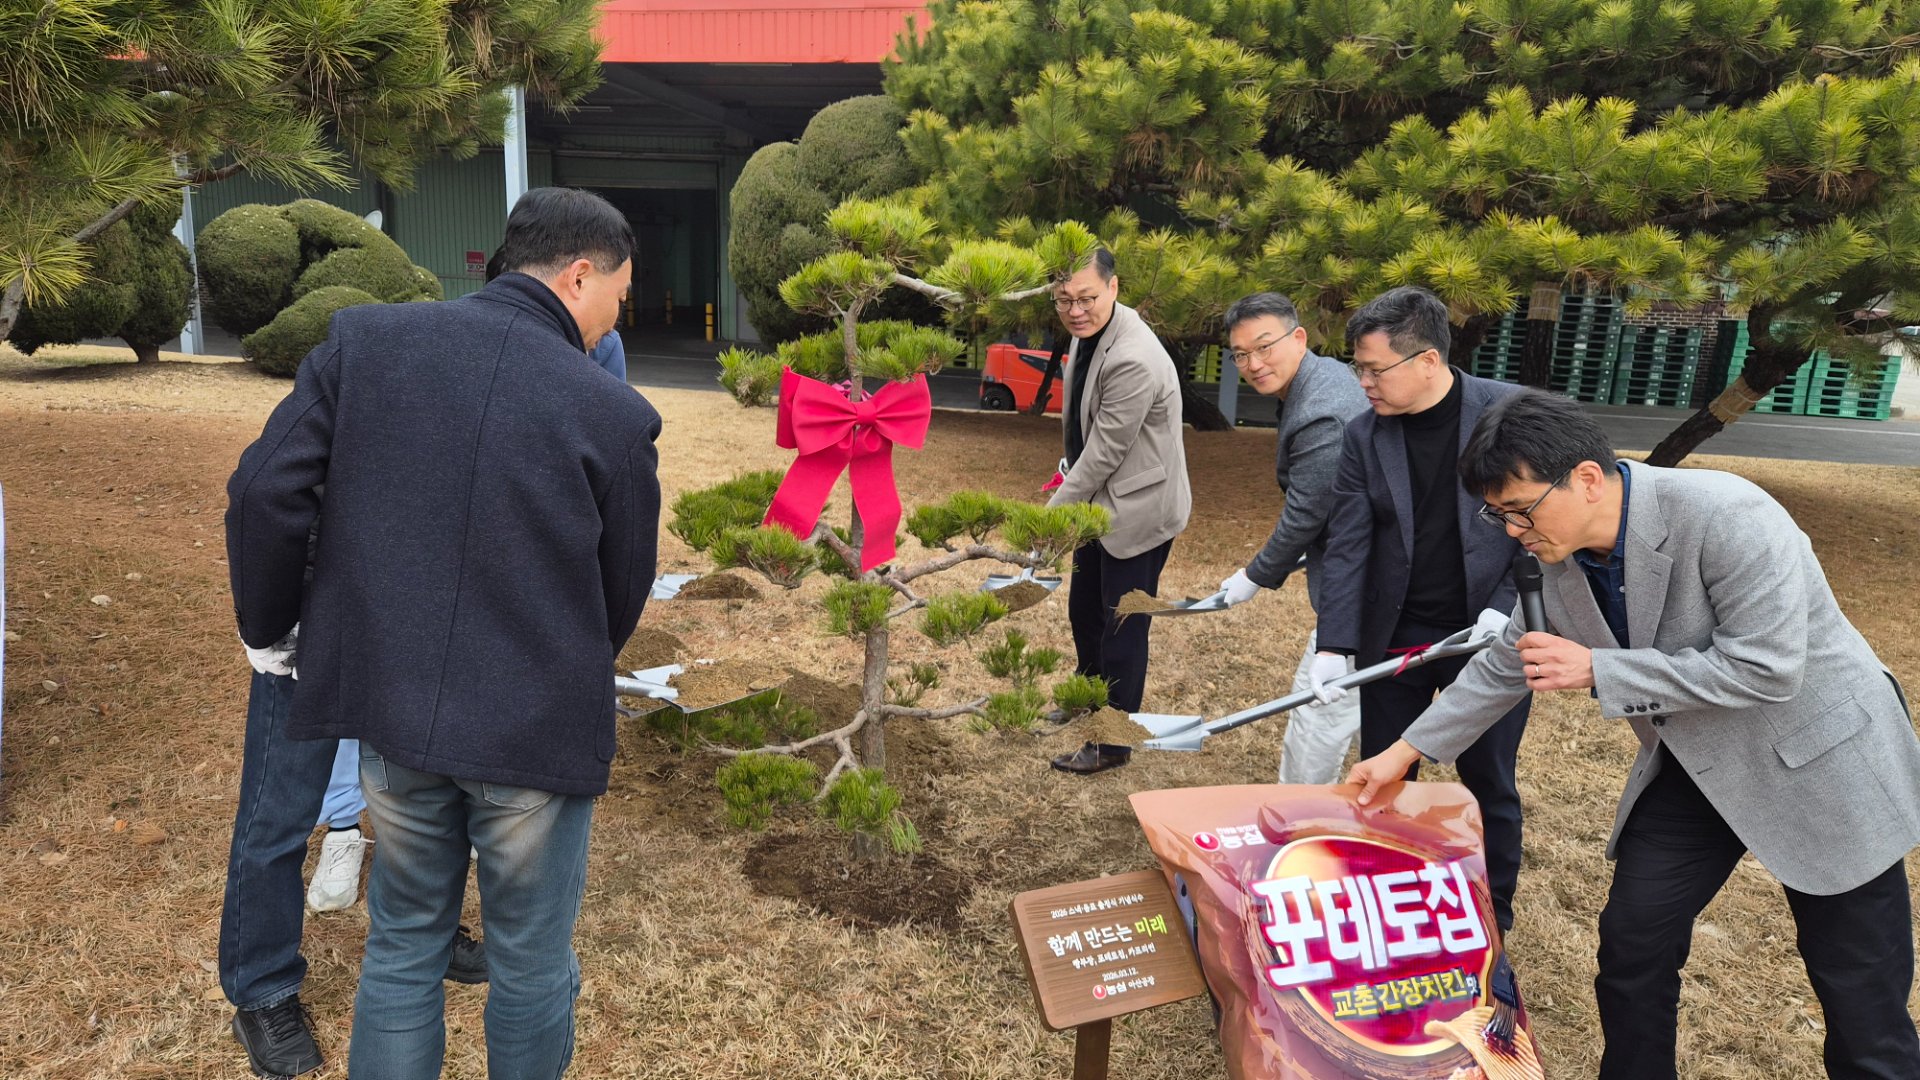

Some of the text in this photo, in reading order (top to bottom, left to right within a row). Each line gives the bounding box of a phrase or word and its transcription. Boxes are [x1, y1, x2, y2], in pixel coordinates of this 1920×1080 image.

[1220, 830, 1266, 849] 농심
[1050, 908, 1068, 919] 2026
[1252, 861, 1488, 986] 포테토칩
[1047, 914, 1168, 957] 함께 만드는 미래
[1105, 975, 1155, 996] 농심 아산공장
